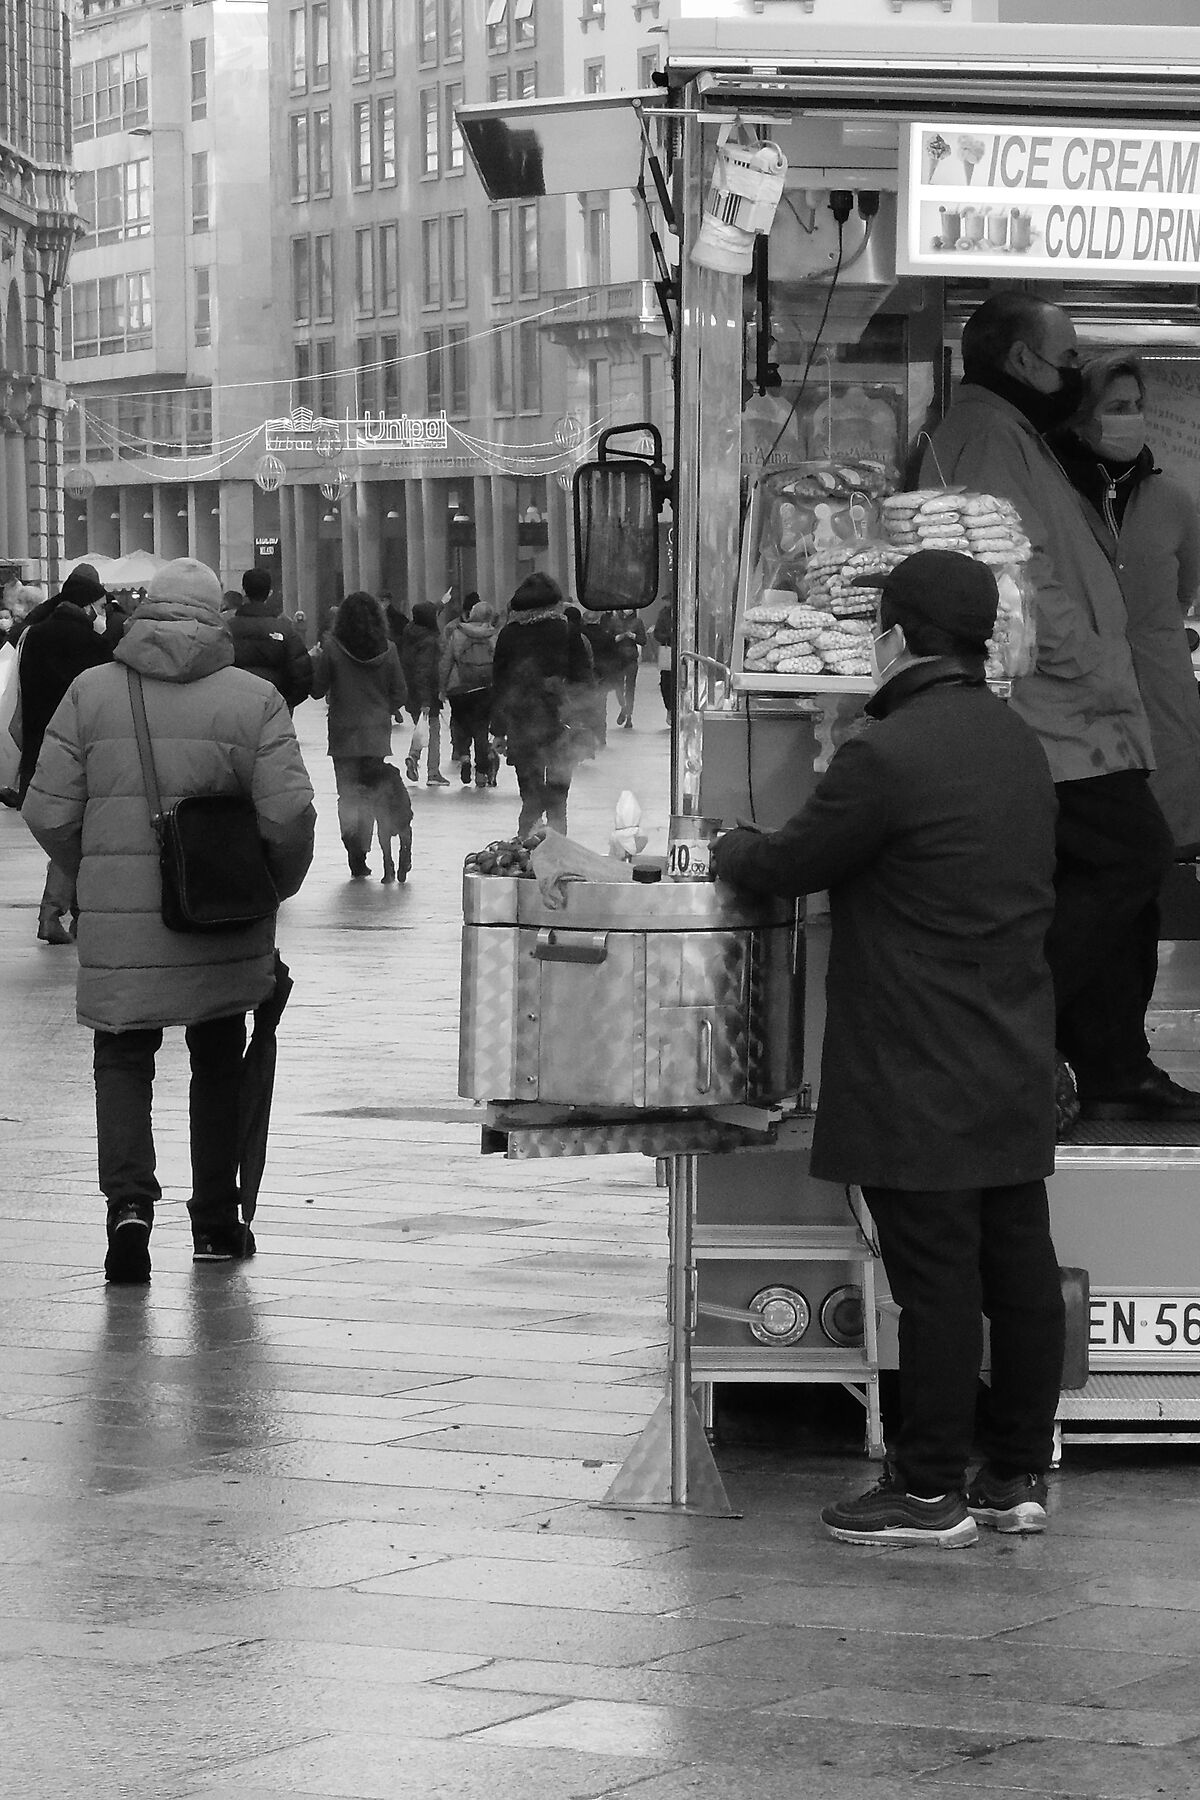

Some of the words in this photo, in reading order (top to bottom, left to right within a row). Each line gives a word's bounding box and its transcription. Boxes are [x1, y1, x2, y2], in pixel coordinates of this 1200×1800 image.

[988, 135, 1053, 188] ICE
[1062, 137, 1200, 194] CREAM
[1045, 204, 1125, 259] COLD
[365, 410, 446, 444] Unipol
[1089, 1301, 1135, 1344] EN
